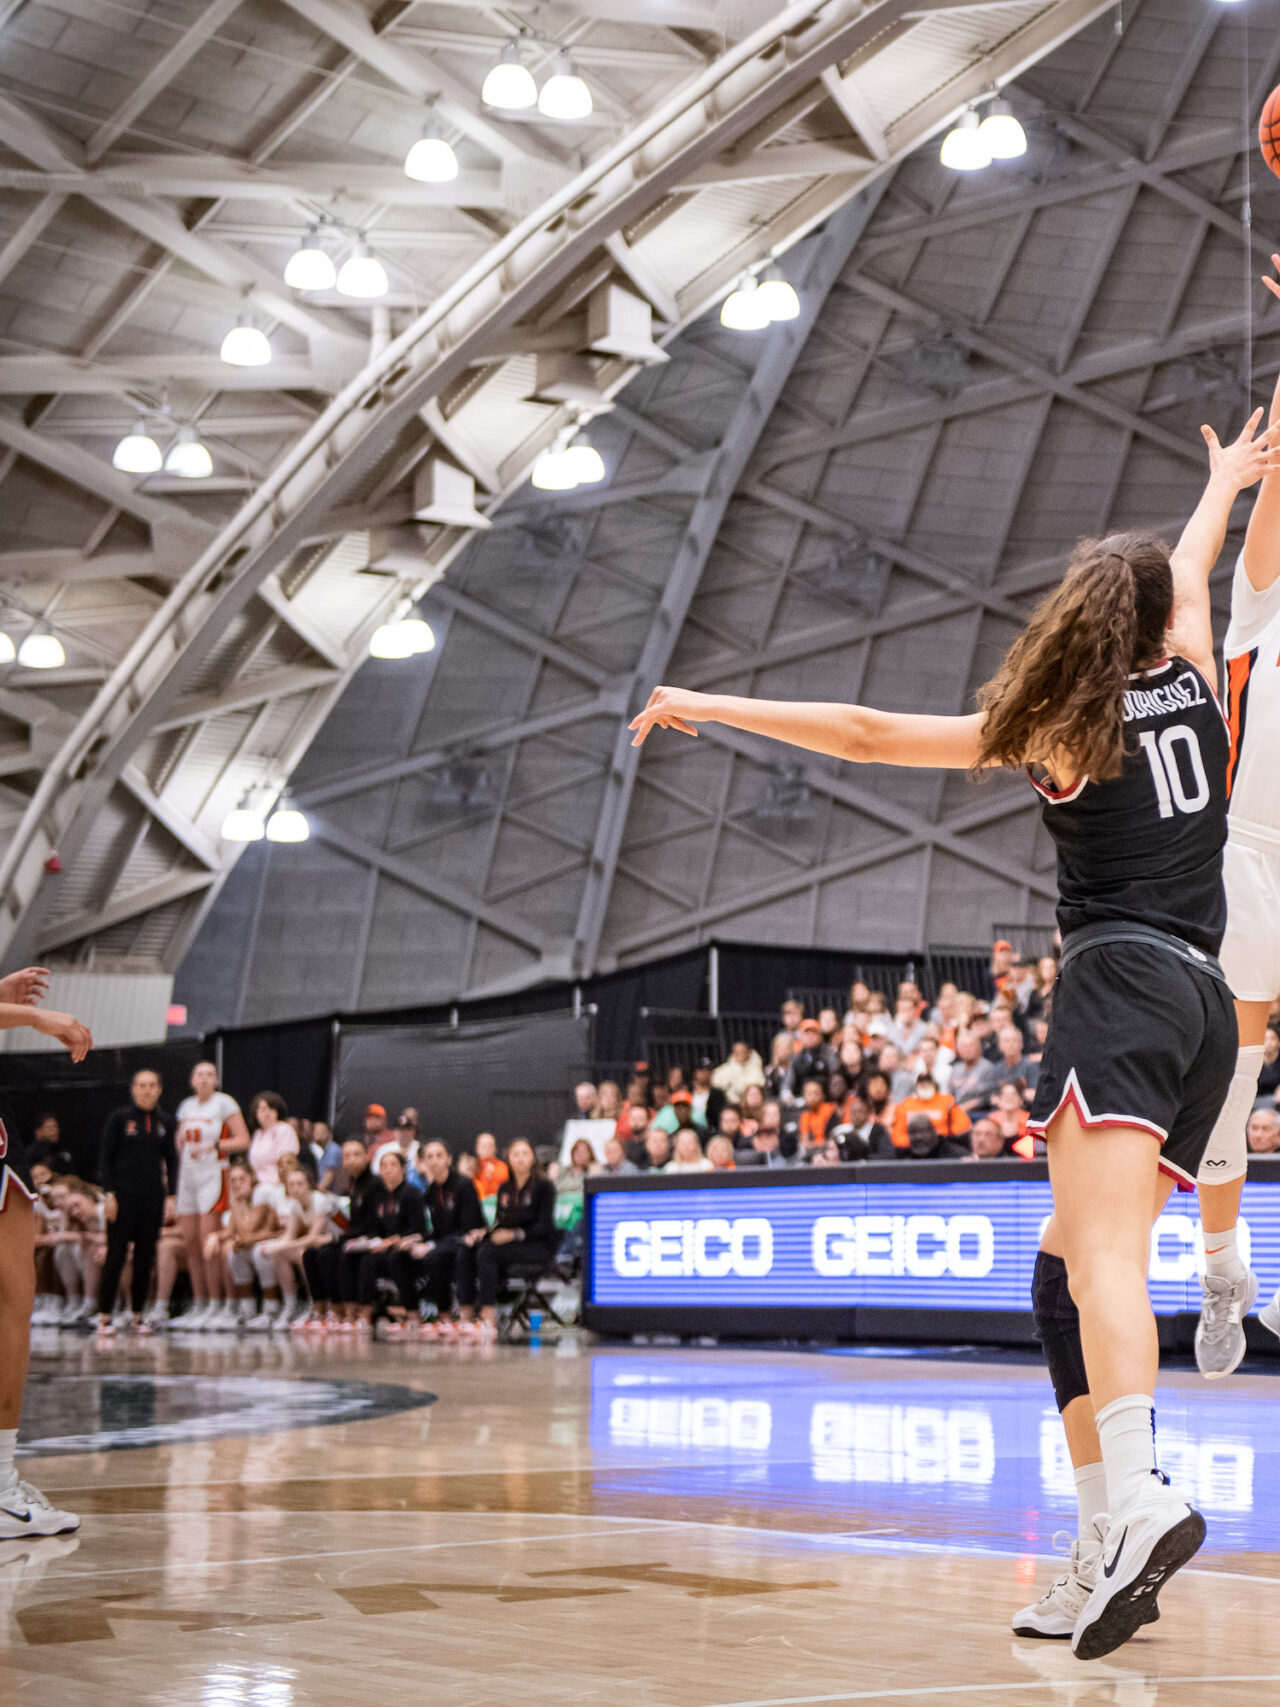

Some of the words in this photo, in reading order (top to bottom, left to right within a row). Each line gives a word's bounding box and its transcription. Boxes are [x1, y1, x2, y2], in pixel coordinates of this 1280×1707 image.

[1122, 671, 1207, 722] ODRIGUEZ
[1139, 725, 1210, 818] 10
[612, 1219, 774, 1278] GEICO
[812, 1215, 995, 1278] GEICO
